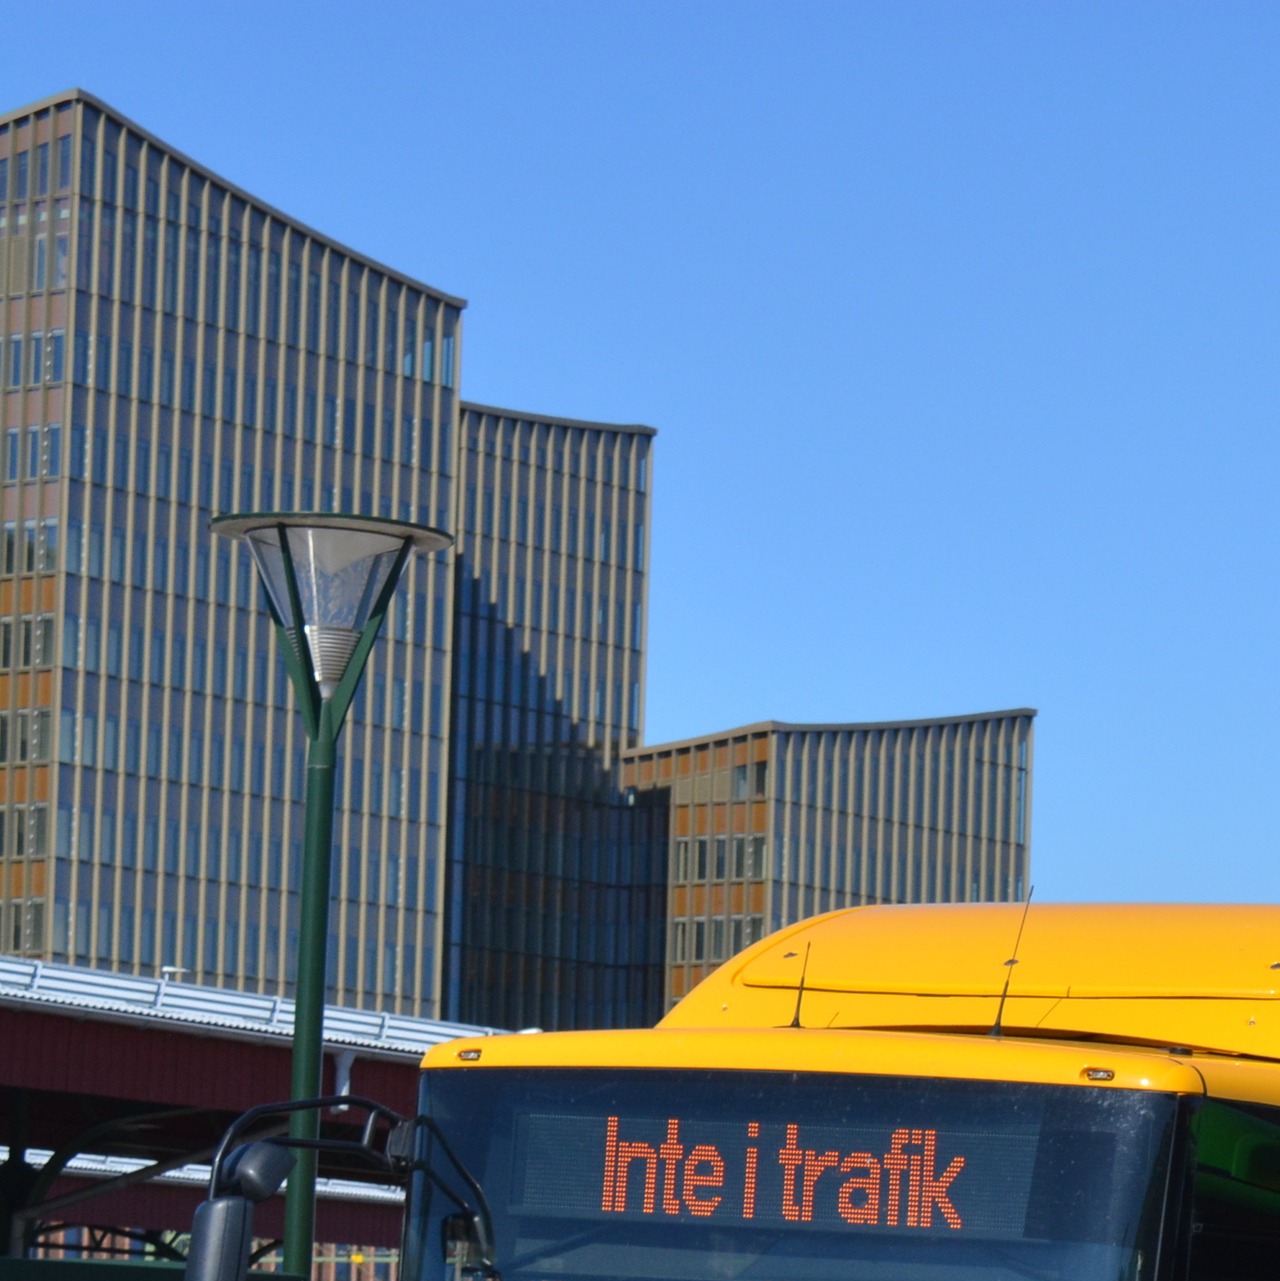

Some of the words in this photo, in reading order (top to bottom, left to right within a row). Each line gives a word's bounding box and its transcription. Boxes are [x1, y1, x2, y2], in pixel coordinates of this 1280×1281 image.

[601, 1116, 725, 1217] Inte
[742, 1121, 760, 1219] i
[778, 1123, 966, 1229] trafik
